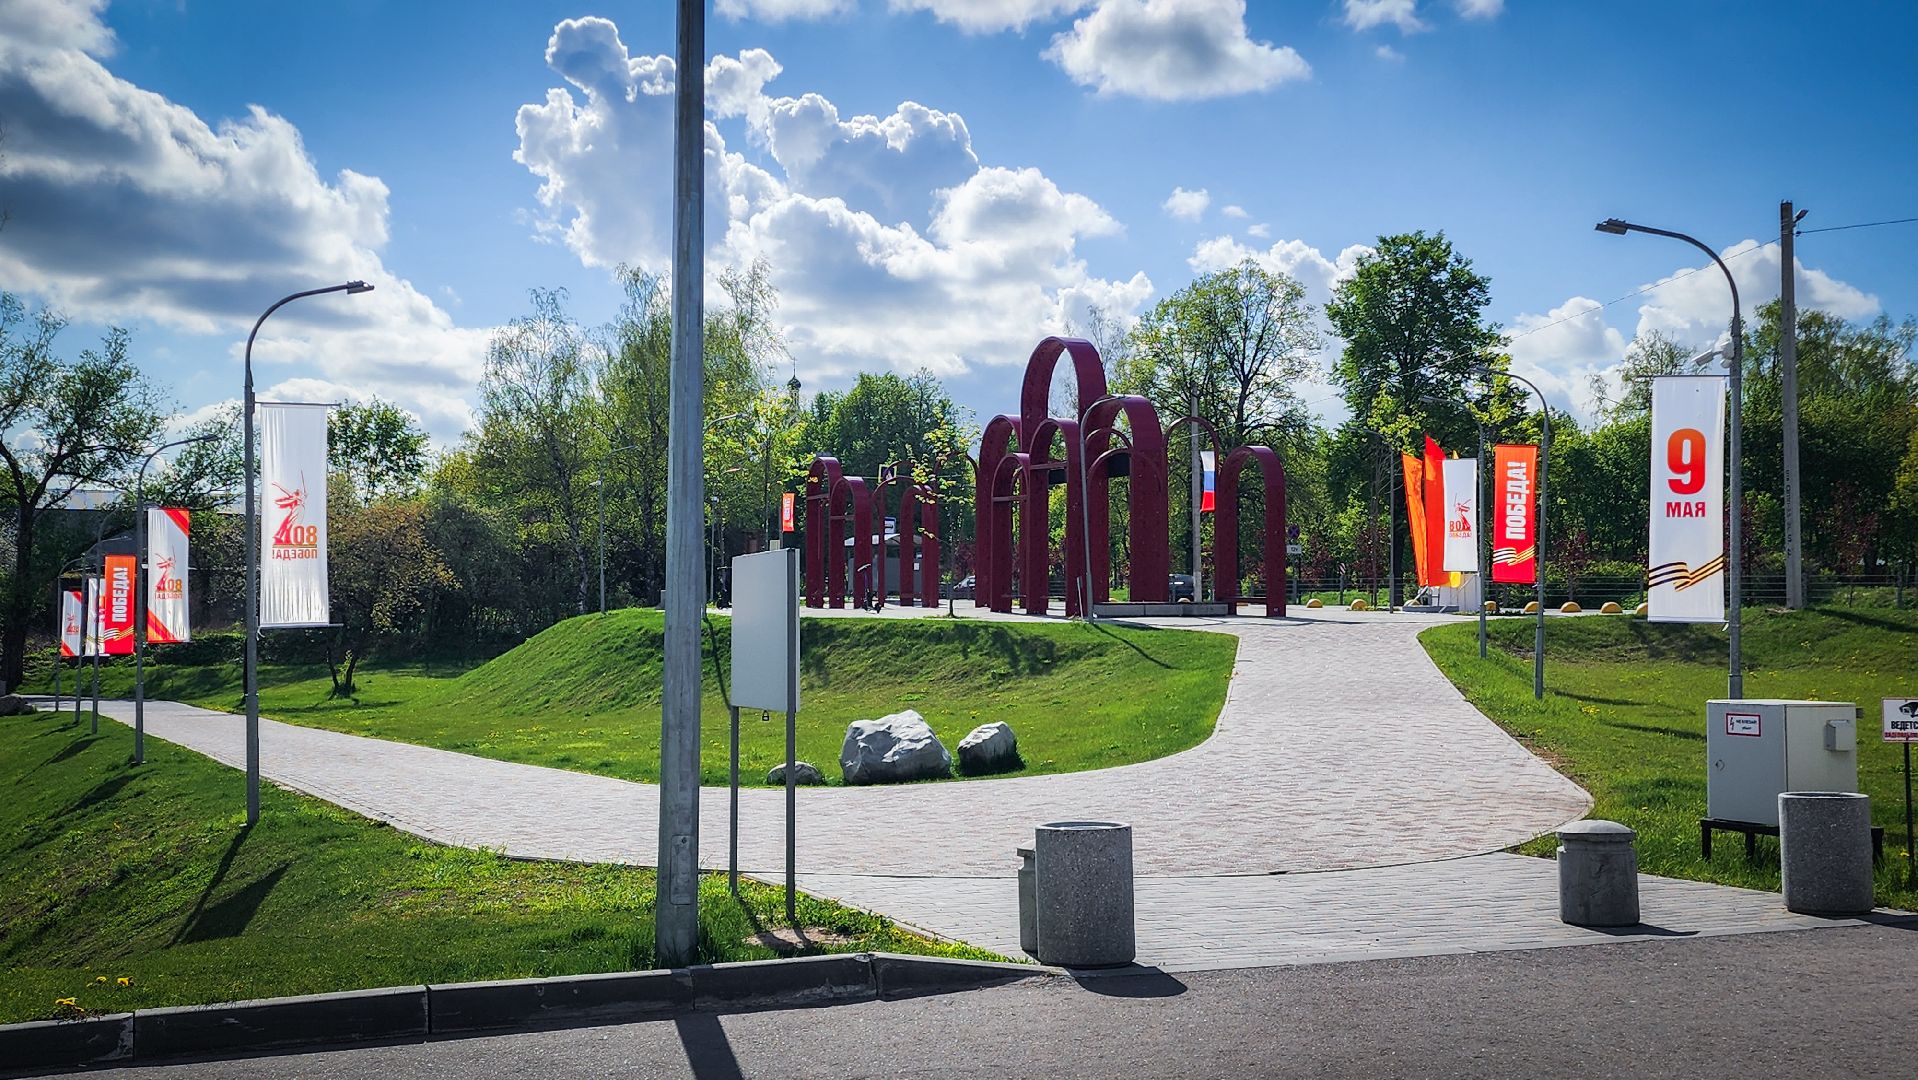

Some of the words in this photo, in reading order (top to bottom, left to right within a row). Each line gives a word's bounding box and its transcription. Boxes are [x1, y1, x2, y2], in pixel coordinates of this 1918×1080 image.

[1667, 428, 1706, 494] 9
[1505, 461, 1530, 540] ПОБЕДА!
[1666, 501, 1706, 518] МАЯ
[111, 567, 130, 623] ПОБЕДА!
